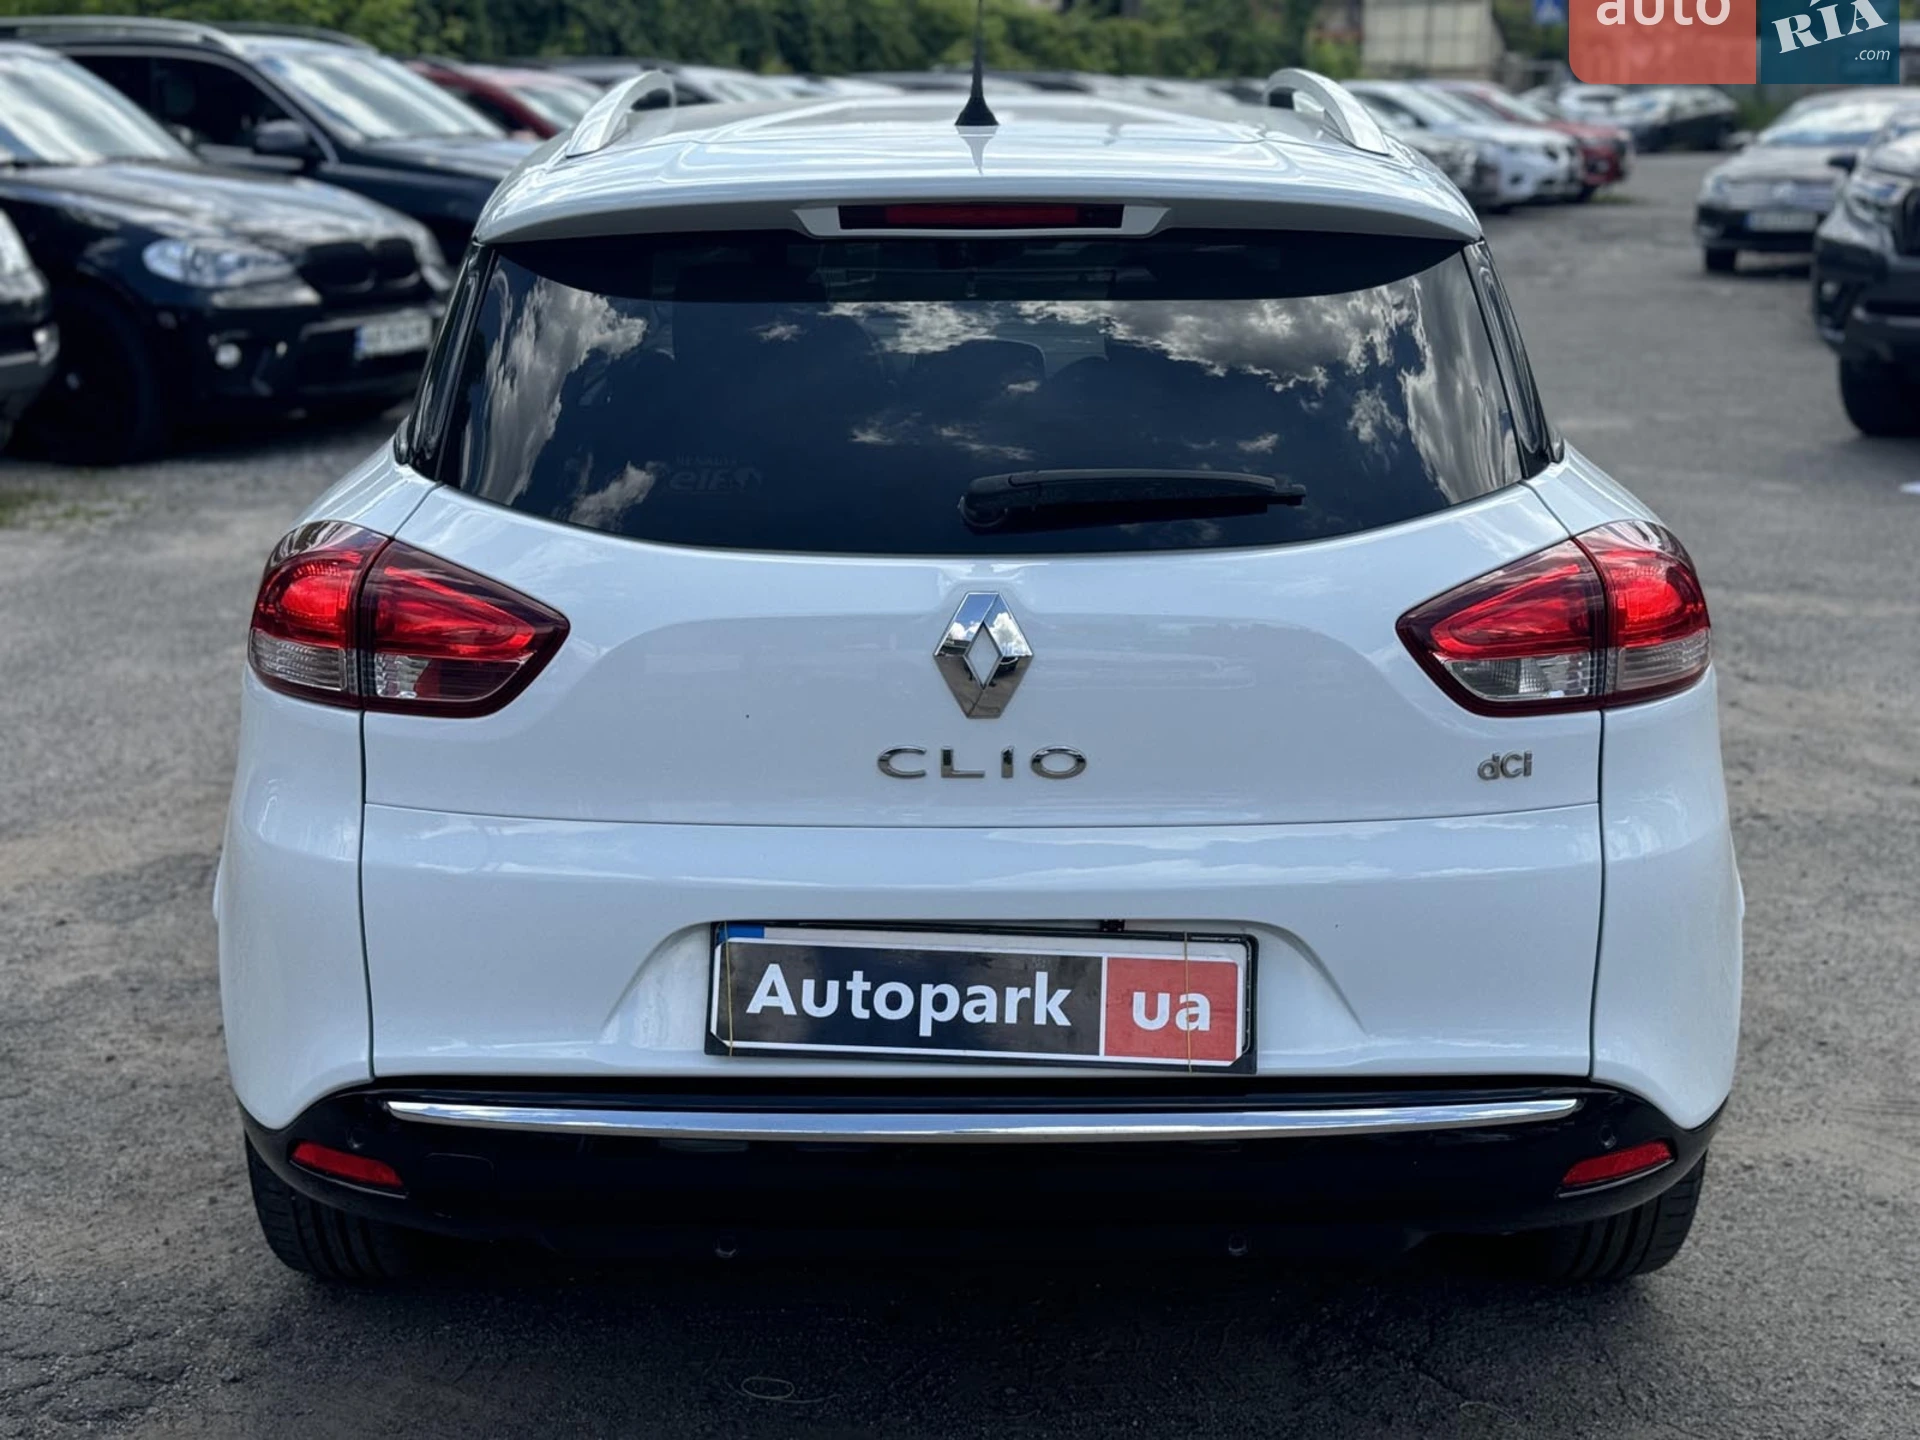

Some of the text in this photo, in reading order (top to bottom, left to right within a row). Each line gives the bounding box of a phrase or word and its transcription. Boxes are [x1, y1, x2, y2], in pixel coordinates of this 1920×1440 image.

[877, 745, 1087, 780] CLIO
[746, 963, 1211, 1037] Autopark ua
